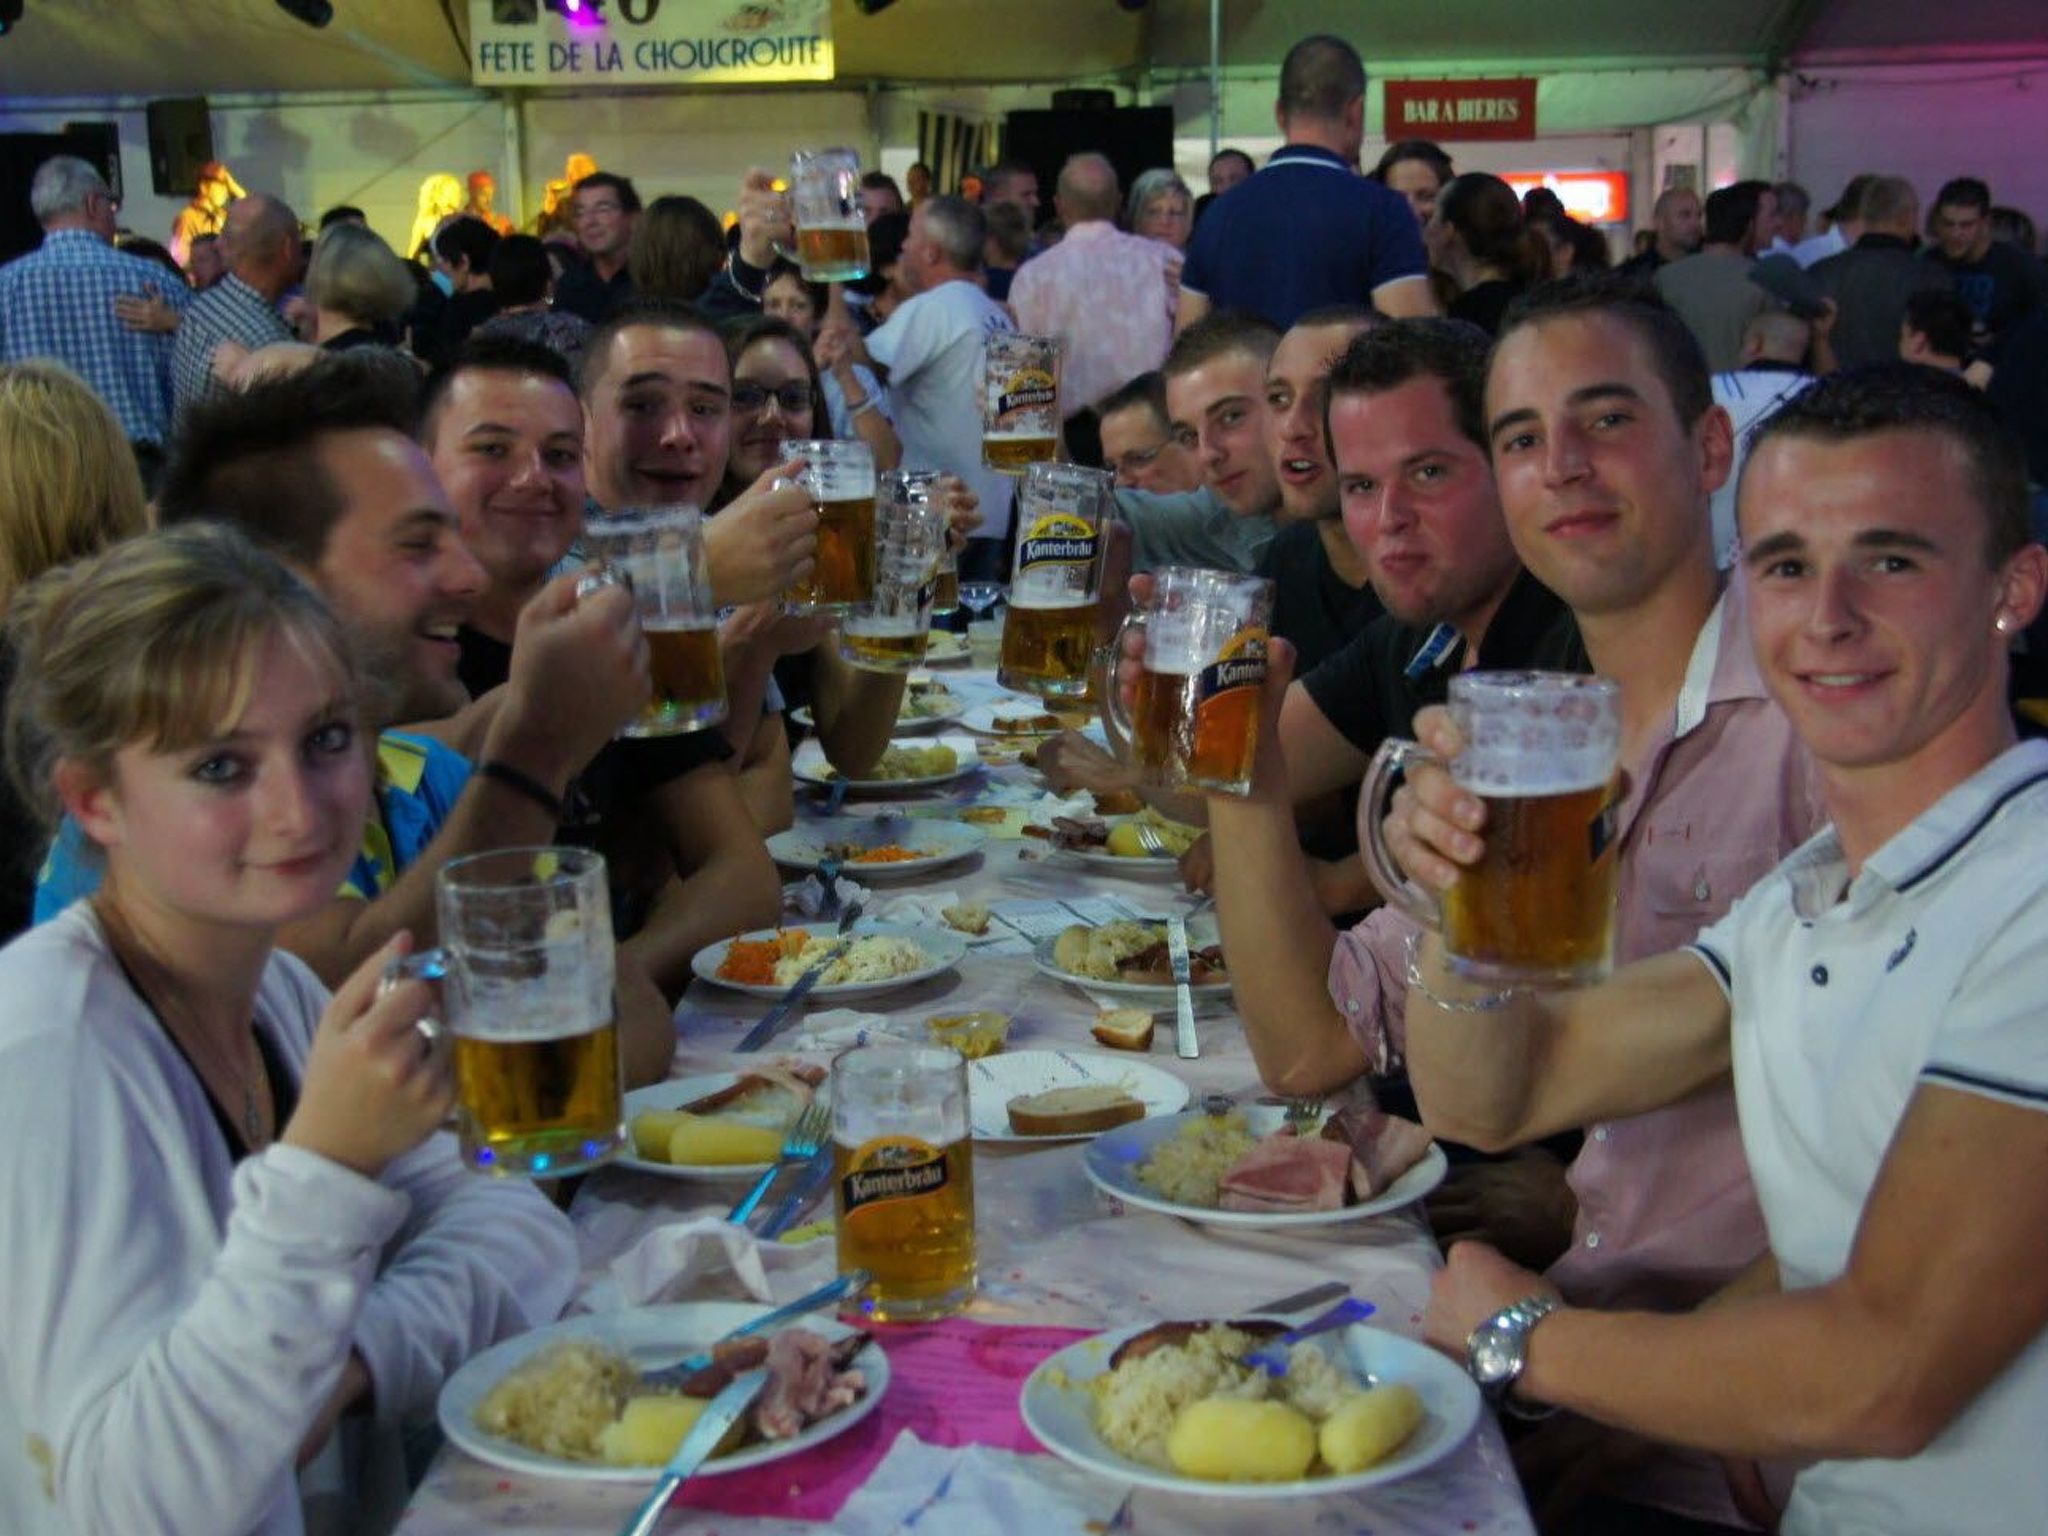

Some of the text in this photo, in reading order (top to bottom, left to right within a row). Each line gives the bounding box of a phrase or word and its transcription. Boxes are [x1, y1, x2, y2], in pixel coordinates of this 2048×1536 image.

[479, 35, 822, 73] FETE DE LA CHOUCROUTE
[1403, 99, 1439, 123] BAR
